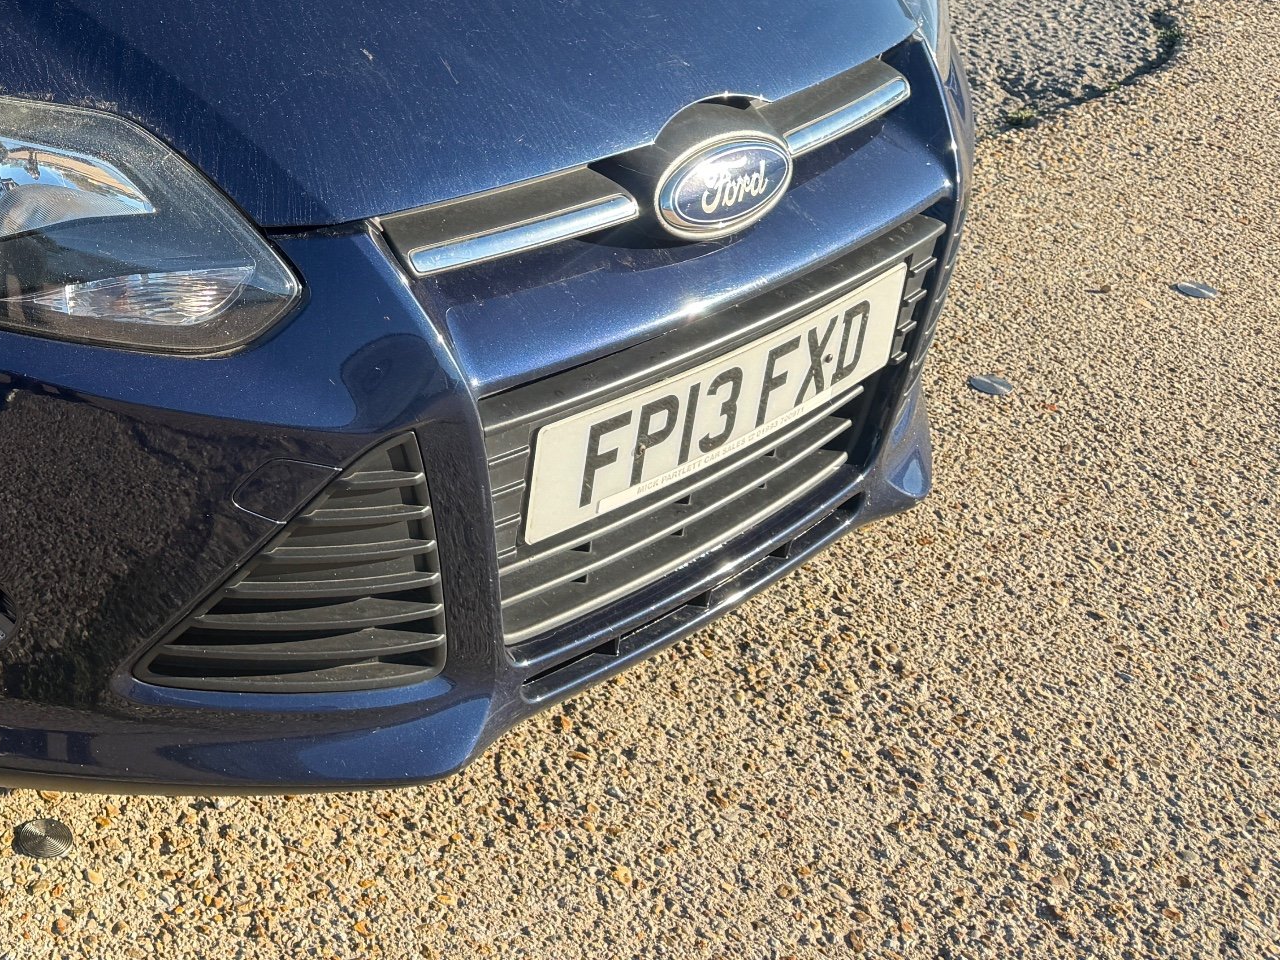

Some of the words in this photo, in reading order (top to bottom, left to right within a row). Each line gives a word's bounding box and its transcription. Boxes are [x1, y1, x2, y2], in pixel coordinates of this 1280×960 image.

[701, 156, 768, 214] Ford
[579, 366, 744, 509] FP13
[754, 300, 871, 430] FXD
[637, 479, 659, 494] MICK
[704, 451, 720, 464] CAR
[722, 437, 746, 456] SALES
